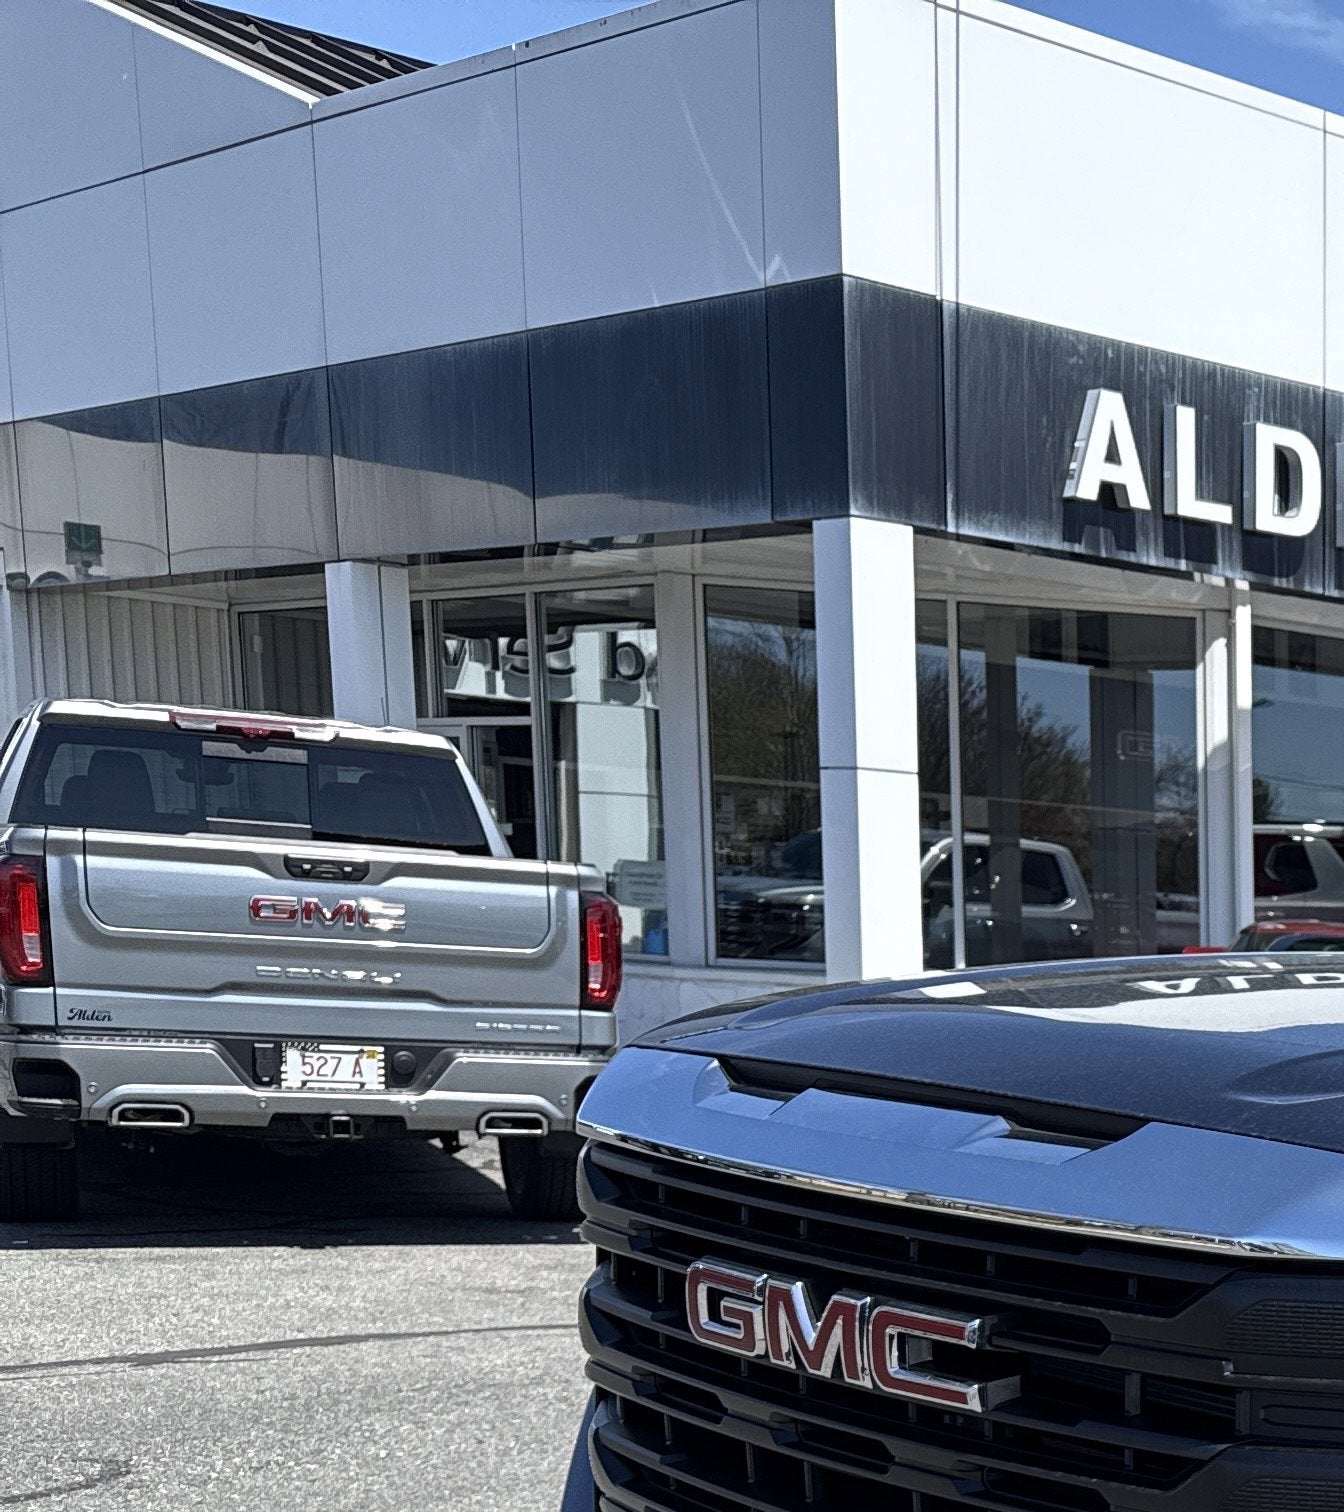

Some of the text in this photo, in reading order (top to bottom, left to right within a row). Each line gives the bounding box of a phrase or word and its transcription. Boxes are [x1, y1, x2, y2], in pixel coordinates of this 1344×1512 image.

[250, 894, 406, 931] GMC
[67, 1007, 113, 1022] Alden
[302, 1055, 342, 1078] 527
[686, 1261, 983, 1413] GMC
